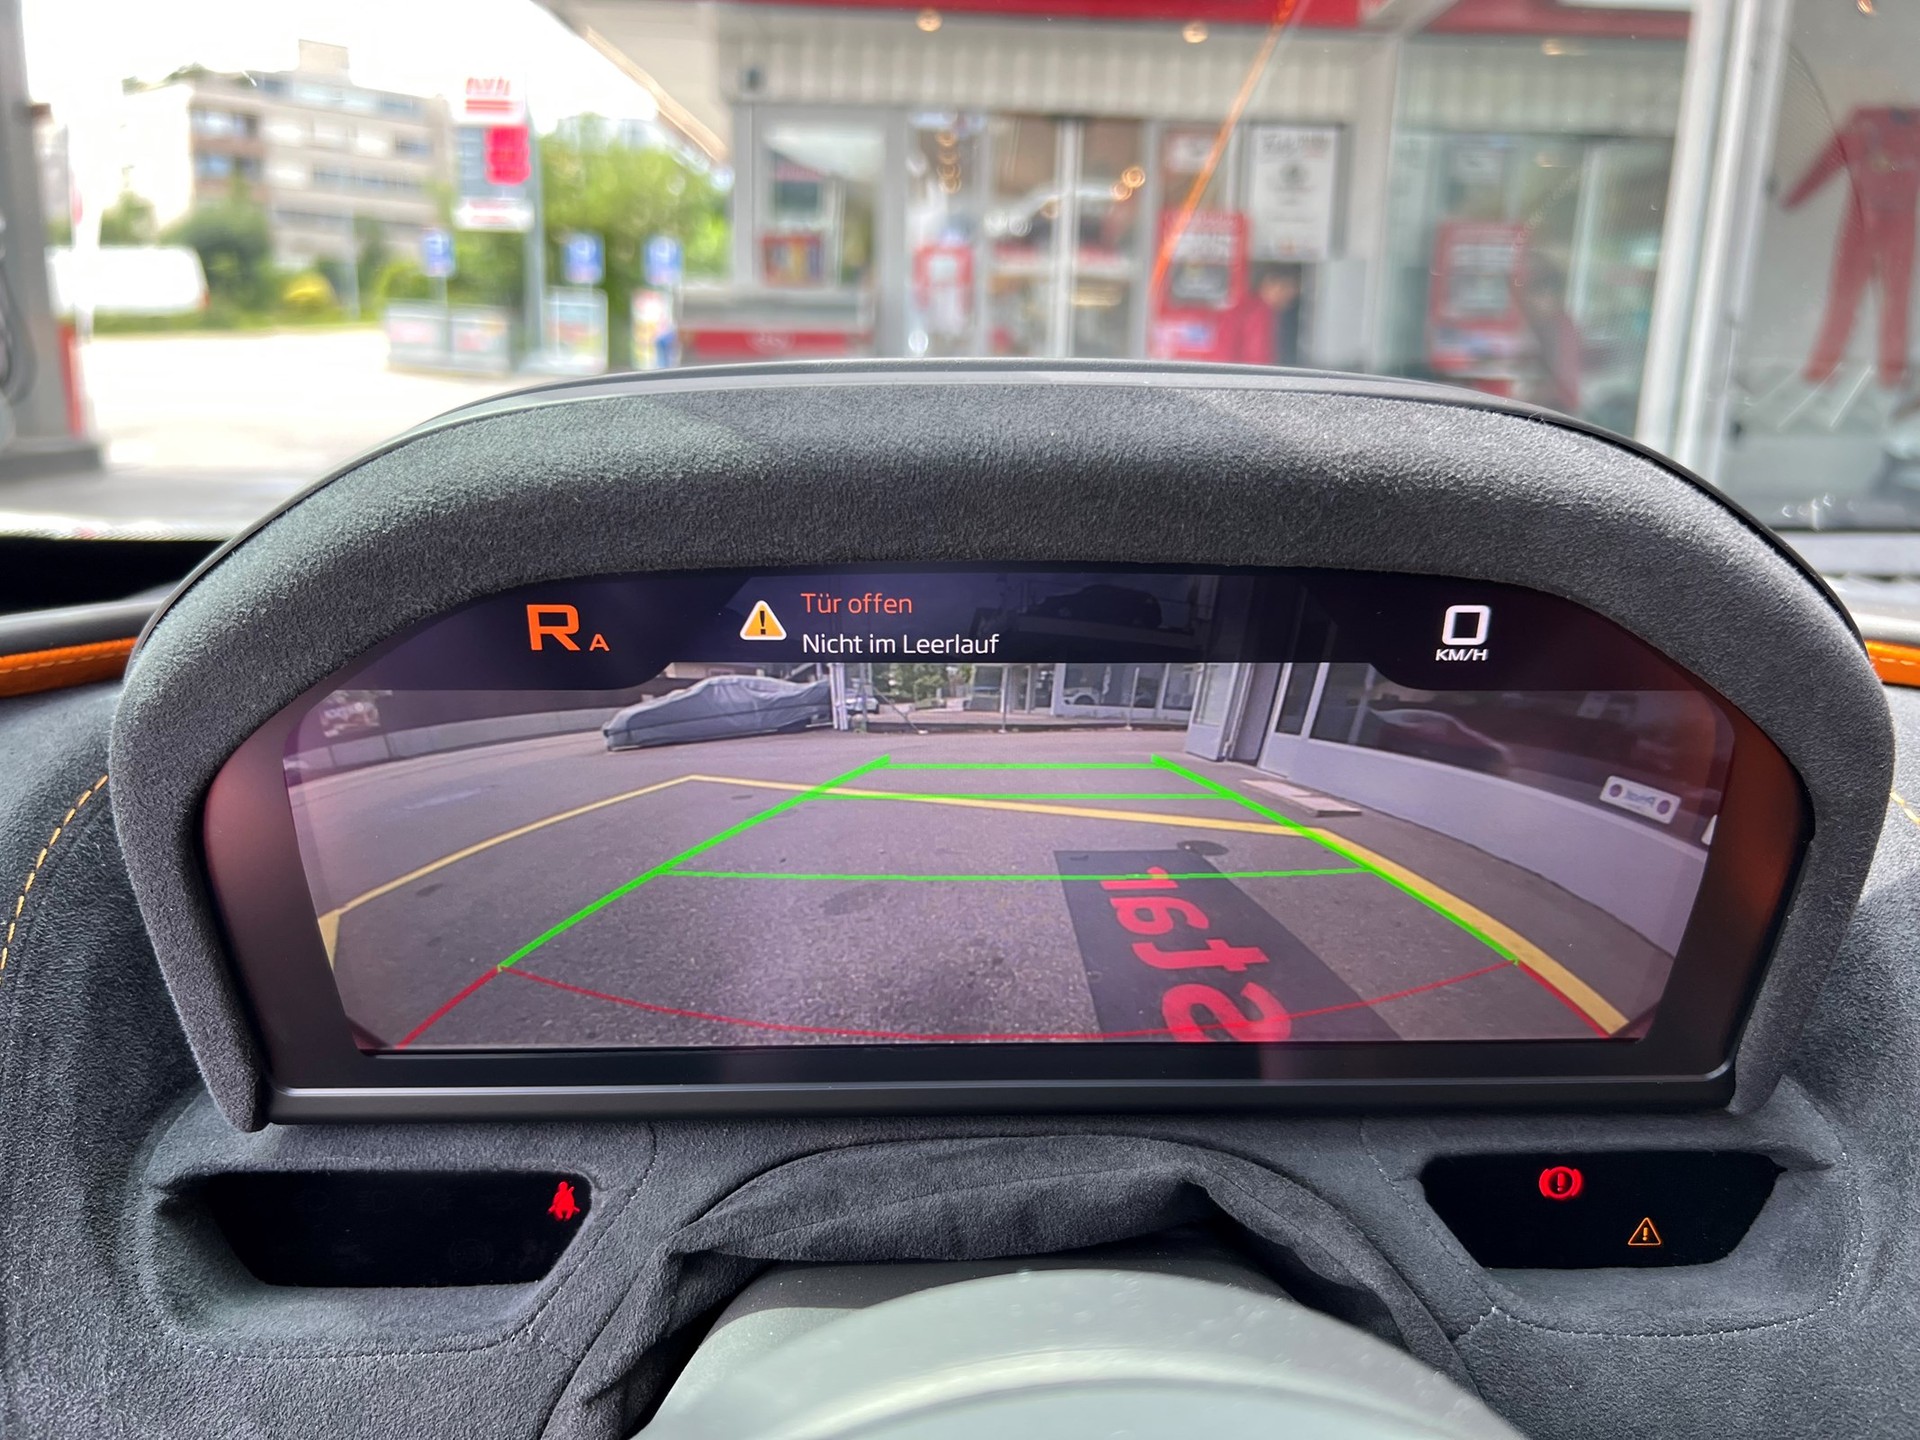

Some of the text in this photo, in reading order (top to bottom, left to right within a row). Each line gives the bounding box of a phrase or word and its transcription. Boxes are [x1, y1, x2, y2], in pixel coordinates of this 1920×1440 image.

[800, 592, 913, 614] Tür offen
[1442, 604, 1491, 646] 0
[802, 633, 1000, 654] Nicht im Leerlauf
[1434, 648, 1488, 662] KM/H
